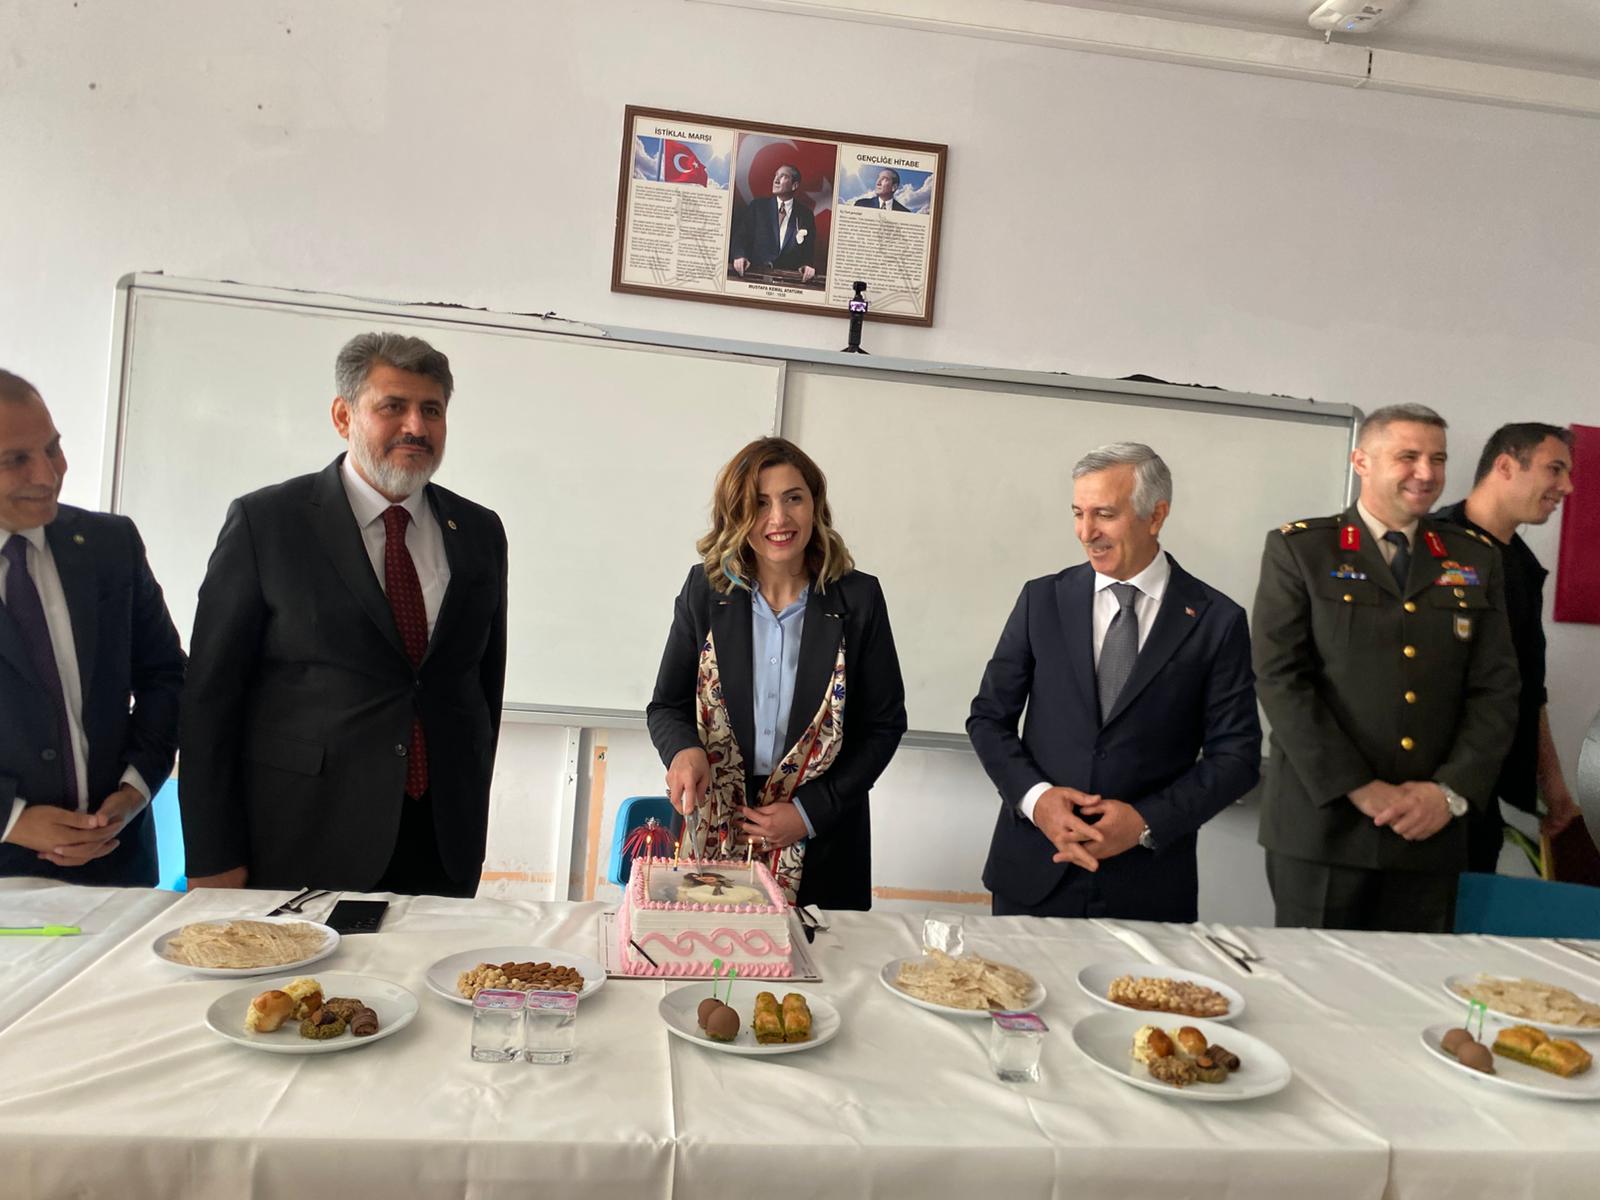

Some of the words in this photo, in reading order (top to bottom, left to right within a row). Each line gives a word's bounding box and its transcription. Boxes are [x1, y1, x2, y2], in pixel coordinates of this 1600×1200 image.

[654, 127, 687, 138] İSTİKLAL
[688, 132, 712, 142] MARŞI
[856, 153, 892, 165] GENÇLİĞE
[894, 157, 920, 168] HİTABE
